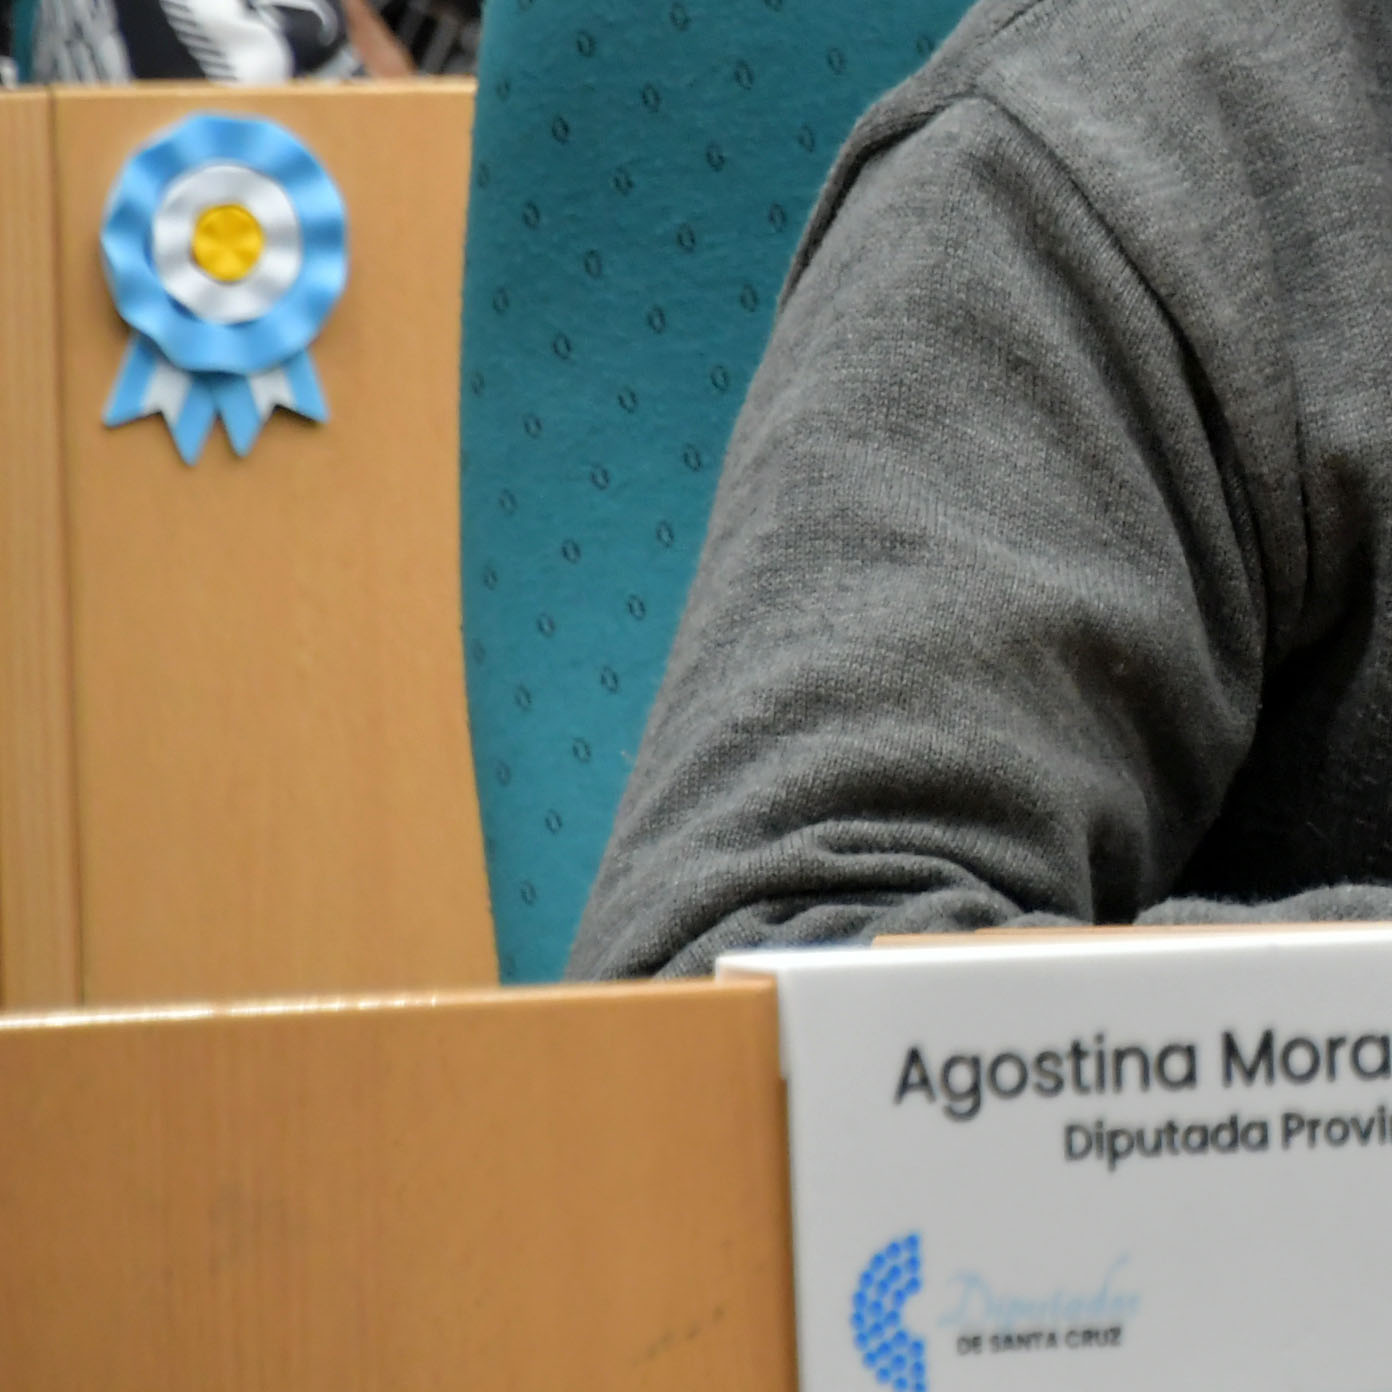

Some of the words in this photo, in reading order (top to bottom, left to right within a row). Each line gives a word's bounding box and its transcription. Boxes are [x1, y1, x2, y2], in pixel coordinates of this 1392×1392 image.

[893, 1031, 1199, 1124] Agostina
[1062, 1111, 1272, 1174] Diputada
[988, 1329, 1059, 1354] SANTA
[1063, 1324, 1123, 1350] CRUZ
